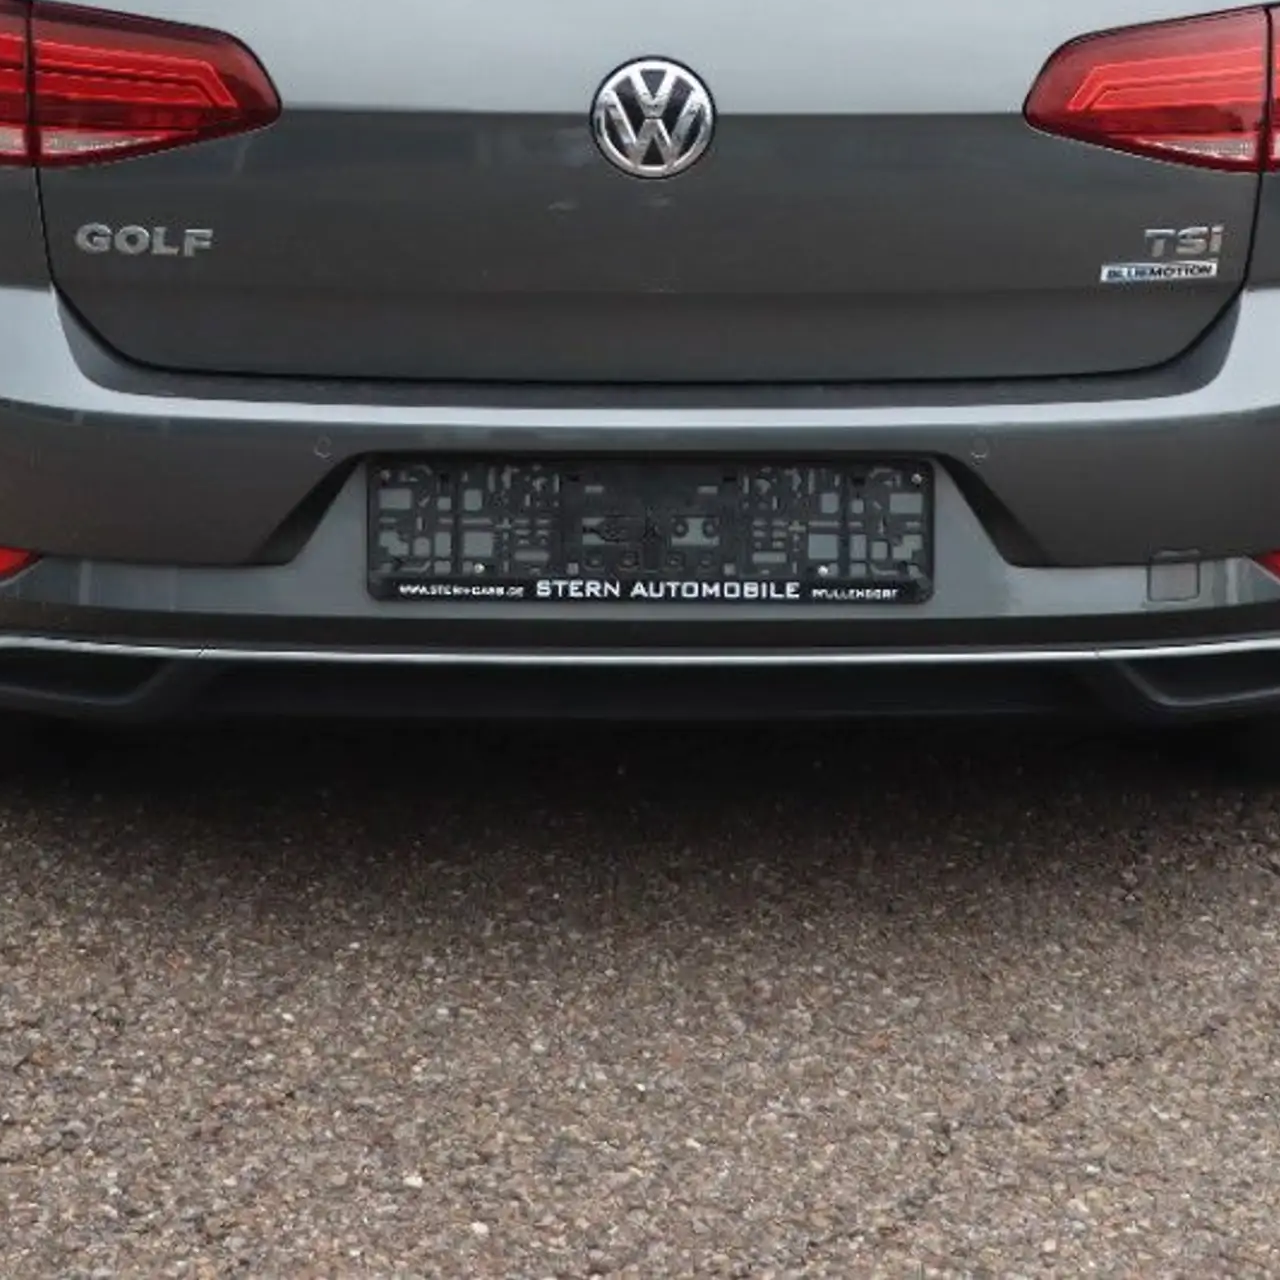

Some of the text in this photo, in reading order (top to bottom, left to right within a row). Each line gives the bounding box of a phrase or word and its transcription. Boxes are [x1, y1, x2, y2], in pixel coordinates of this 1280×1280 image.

[75, 222, 214, 257] GOLF
[536, 579, 621, 599] STERN
[630, 580, 800, 600] AUTOMOBILE
